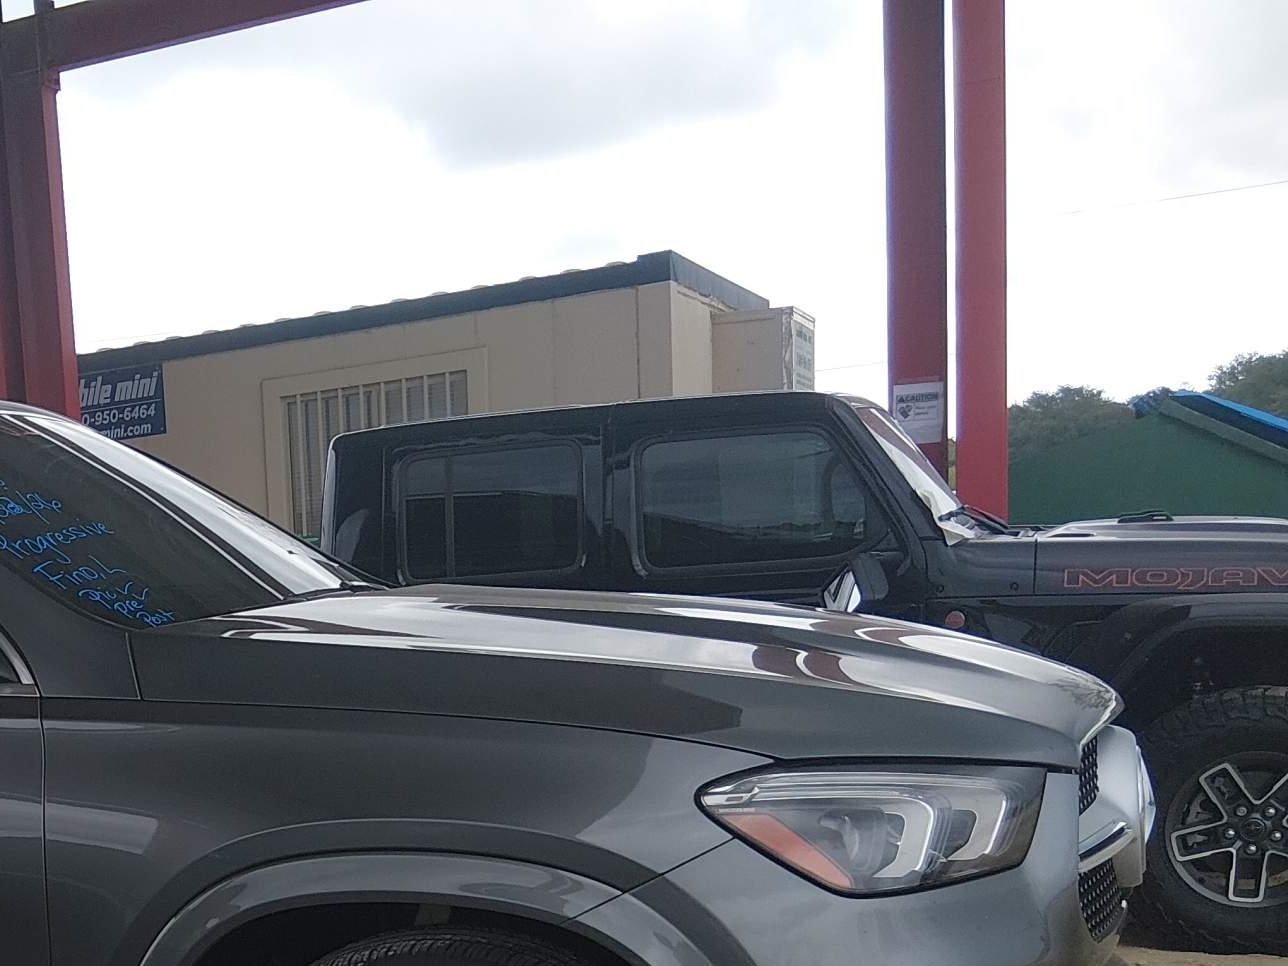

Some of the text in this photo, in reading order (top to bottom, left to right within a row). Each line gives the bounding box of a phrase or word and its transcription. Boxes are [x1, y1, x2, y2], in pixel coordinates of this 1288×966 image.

[79, 371, 158, 408] bile mini
[81, 403, 156, 426] 0-950-6464
[99, 423, 152, 439] mini.com
